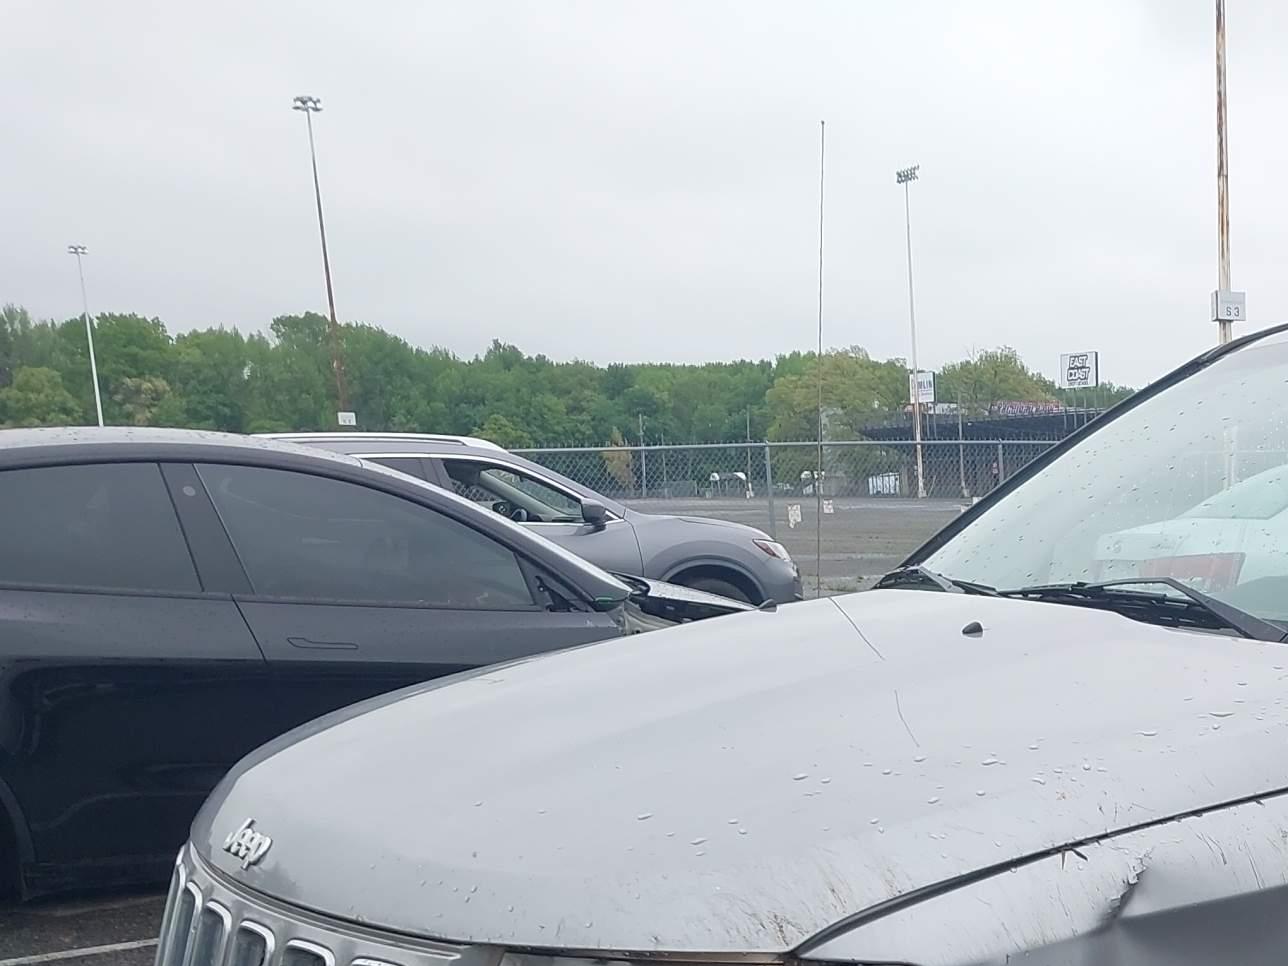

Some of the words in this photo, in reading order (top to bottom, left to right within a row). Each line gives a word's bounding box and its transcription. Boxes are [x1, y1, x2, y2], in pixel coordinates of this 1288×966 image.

[1069, 355, 1088, 368] EAST
[1067, 367, 1090, 381] COAST
[223, 817, 273, 871] Jeep
